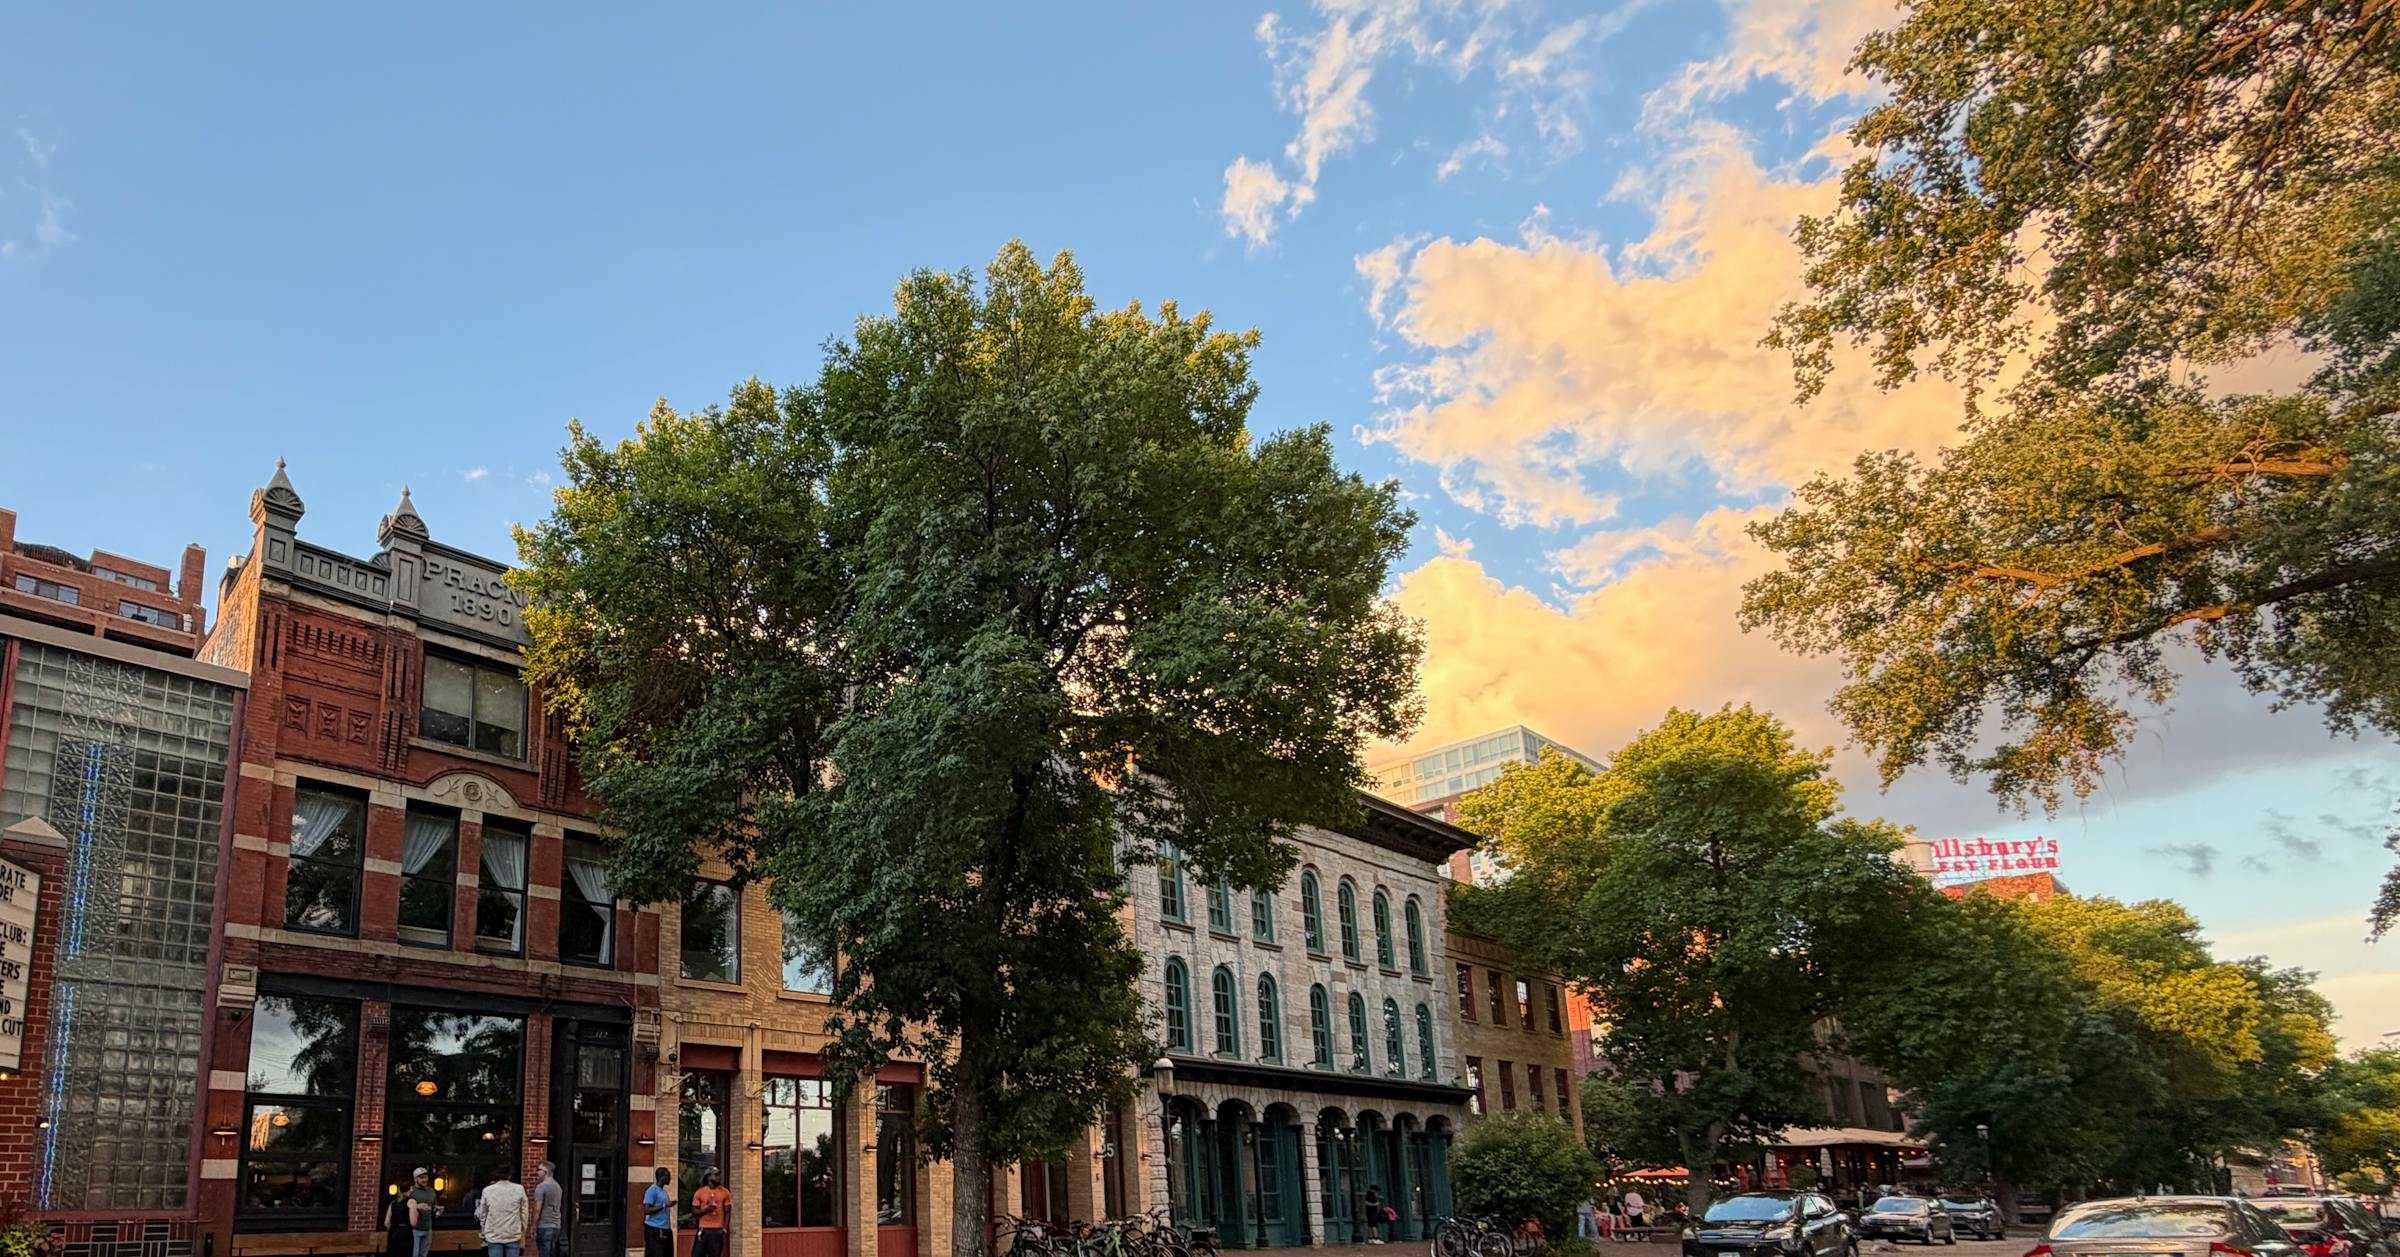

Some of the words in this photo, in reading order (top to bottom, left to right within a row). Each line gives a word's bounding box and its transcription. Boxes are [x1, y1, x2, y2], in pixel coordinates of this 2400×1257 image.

[451, 593, 512, 626] 1890
[1989, 857, 2058, 870] FLOUR
[2, 1018, 22, 1037] CUT
